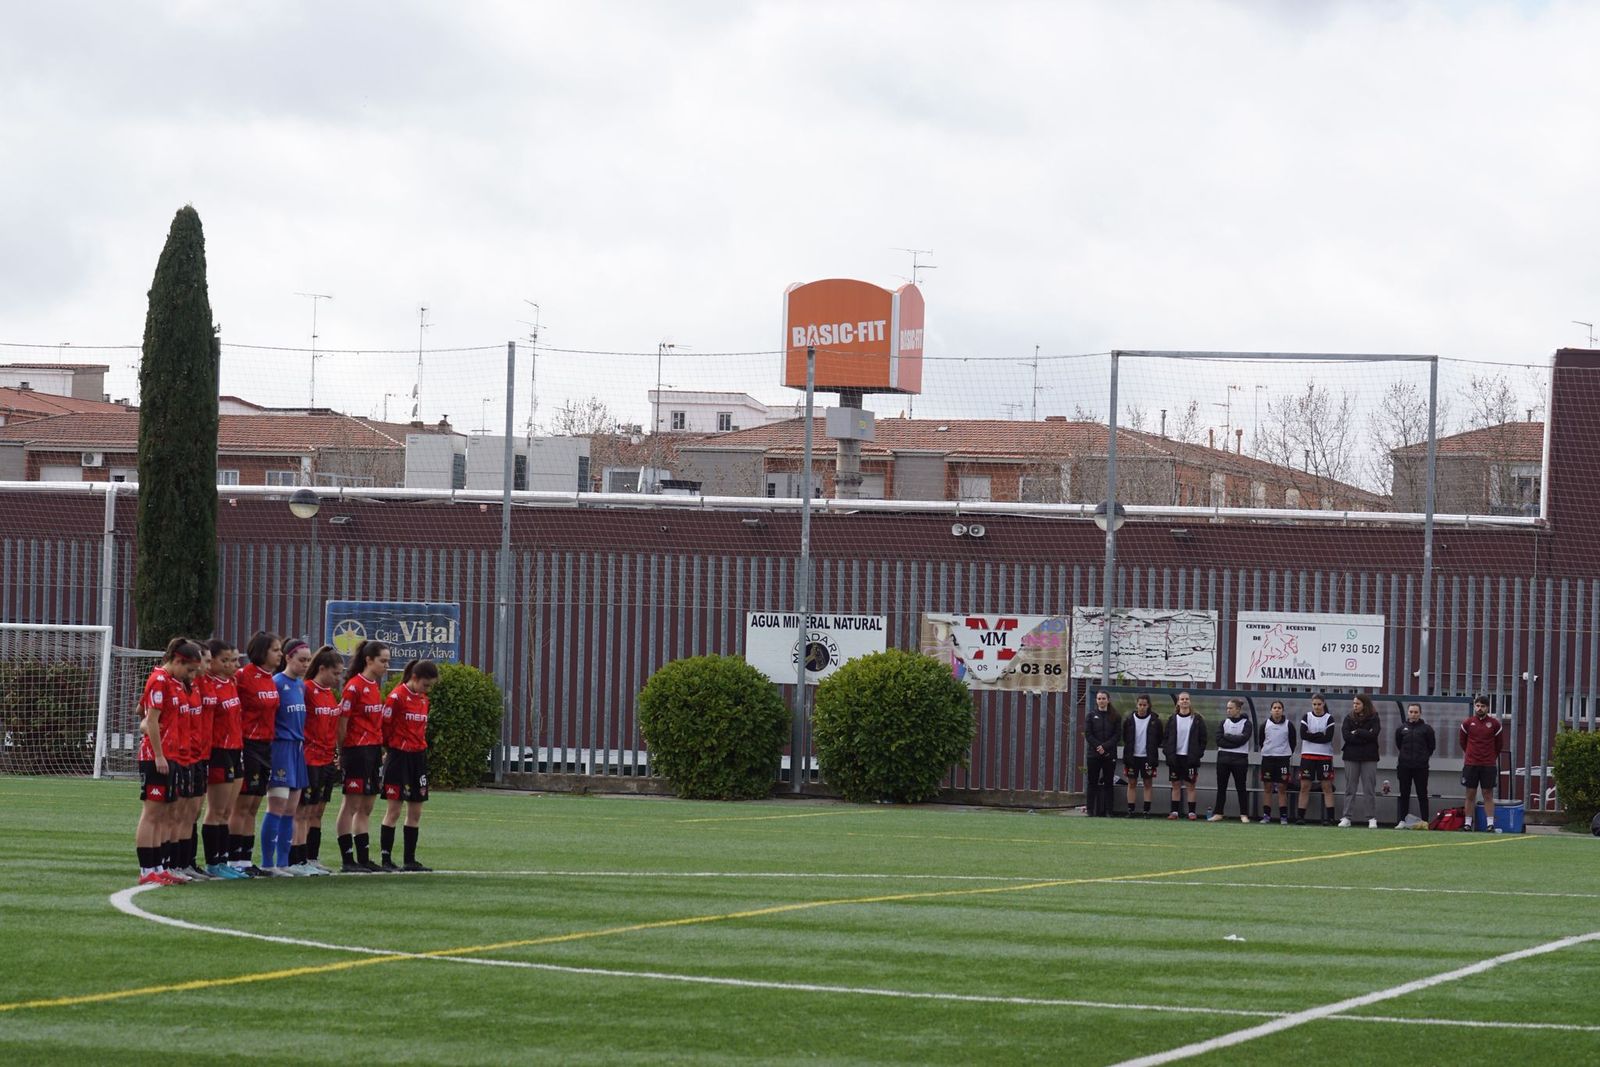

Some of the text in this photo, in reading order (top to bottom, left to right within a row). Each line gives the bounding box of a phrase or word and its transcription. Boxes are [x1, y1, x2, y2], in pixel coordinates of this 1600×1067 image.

[792, 320, 886, 347] BASIC-FIT
[751, 615, 780, 628] AGUA
[833, 617, 882, 631] NATURAL
[375, 620, 456, 644] Caja Vital
[390, 646, 417, 658] itoria
[1321, 643, 1380, 654] 617 930 502
[1021, 663, 1040, 675] 03
[1043, 664, 1062, 676] 86
[1261, 666, 1316, 680] SALAMANCA
